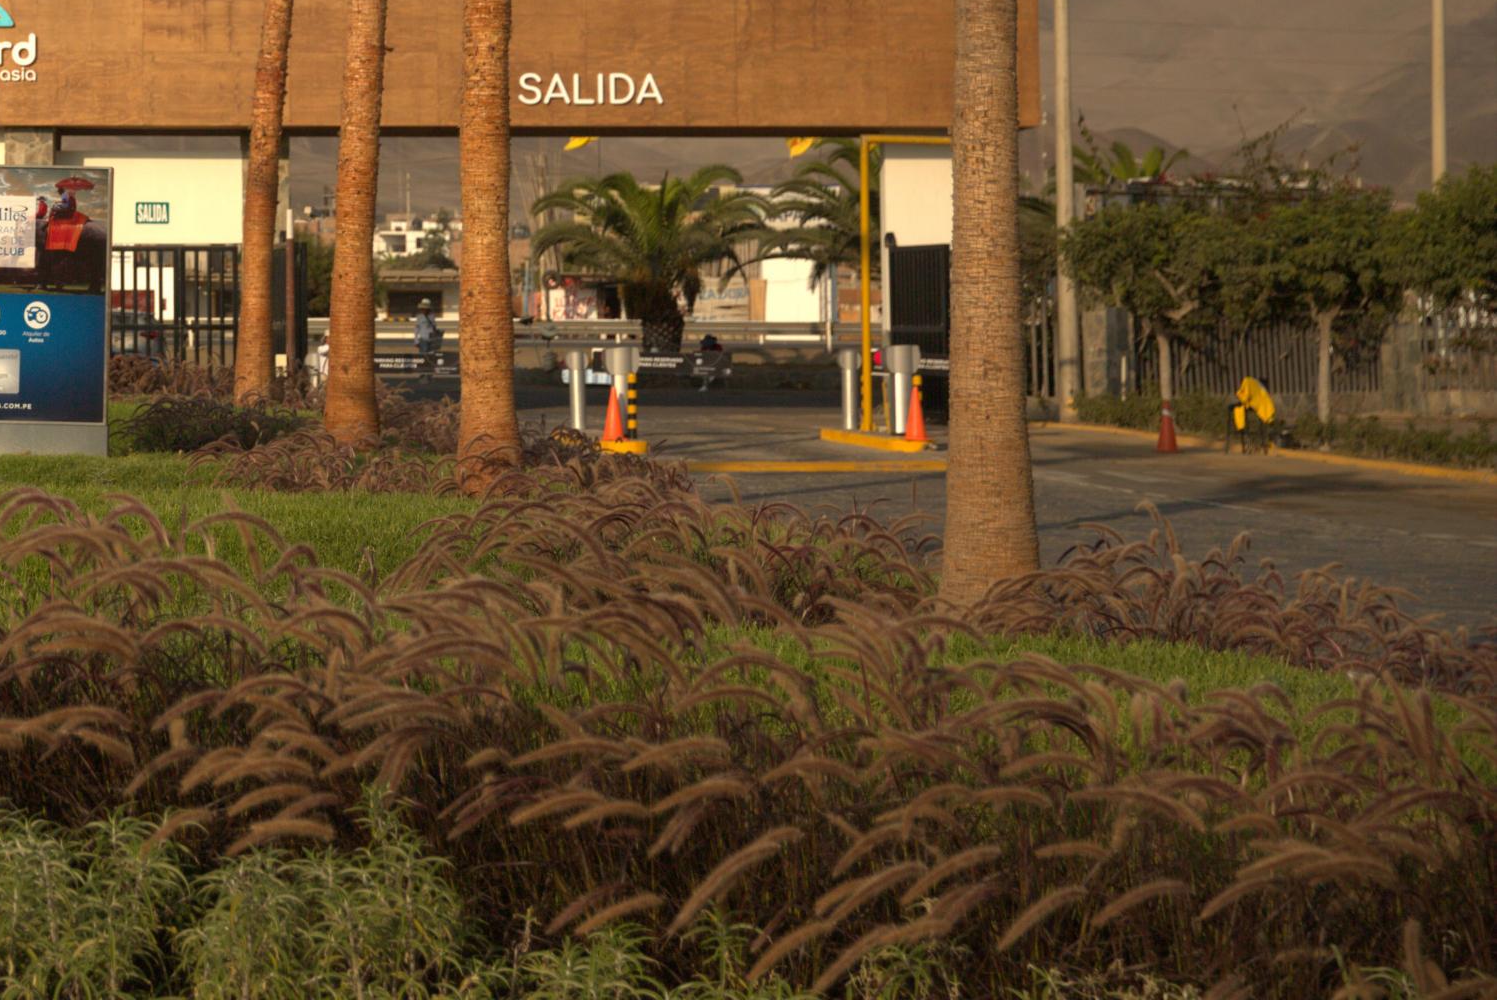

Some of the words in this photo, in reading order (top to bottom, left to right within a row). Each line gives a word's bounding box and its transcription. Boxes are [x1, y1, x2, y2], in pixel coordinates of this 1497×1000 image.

[0, 67, 37, 82] asia
[517, 72, 663, 105] SALIDA
[137, 204, 168, 222] SALIDA
[10, 236, 24, 246] DE
